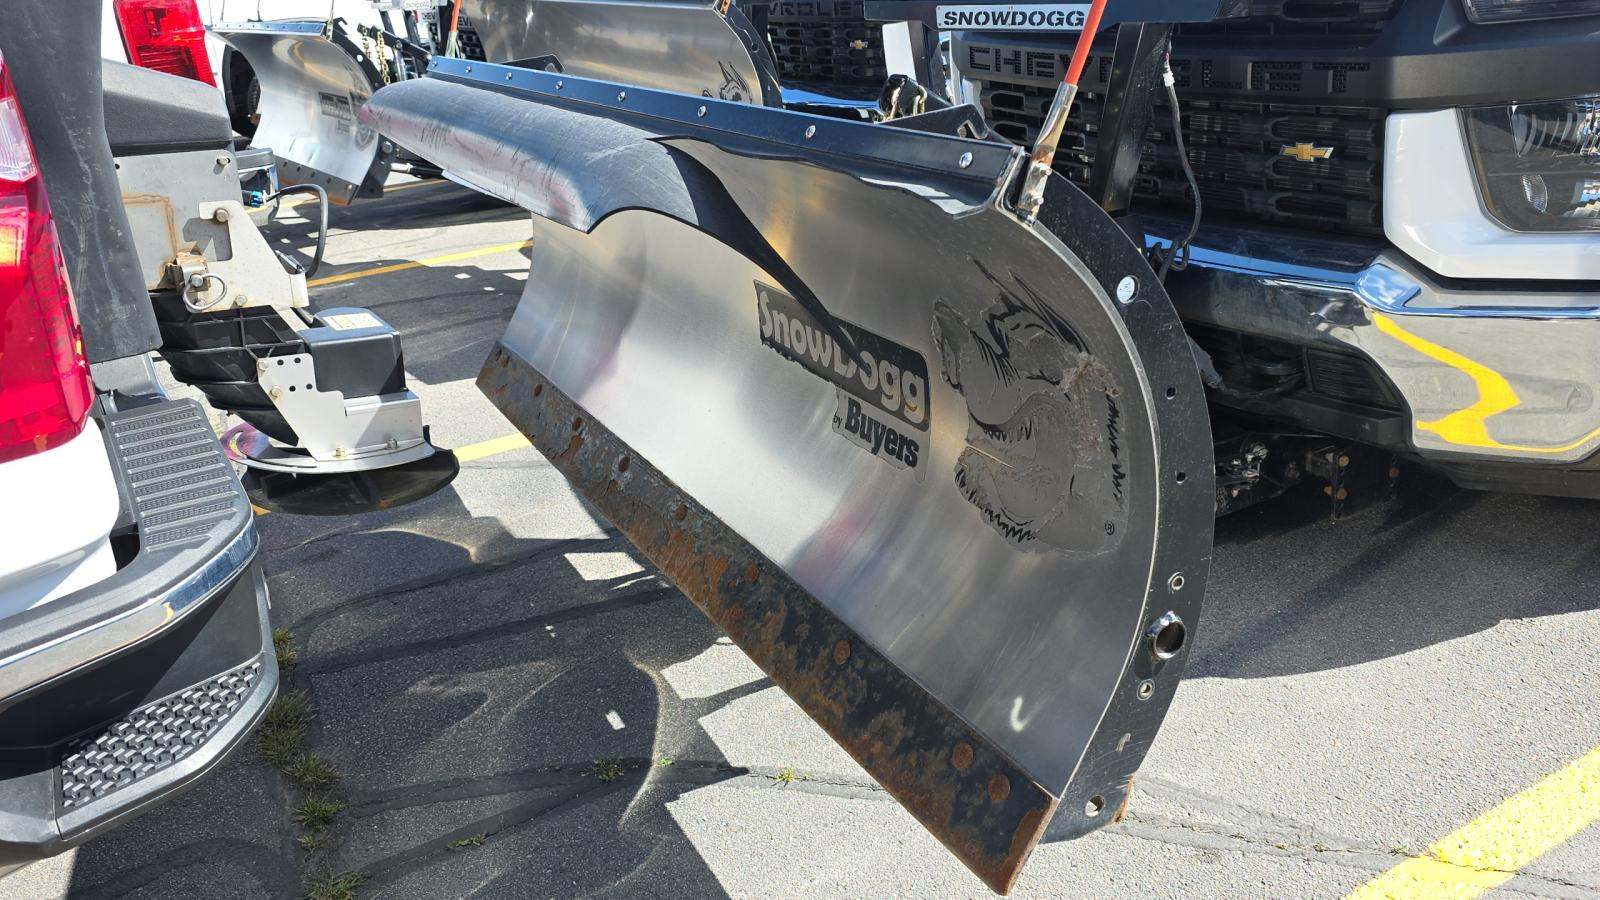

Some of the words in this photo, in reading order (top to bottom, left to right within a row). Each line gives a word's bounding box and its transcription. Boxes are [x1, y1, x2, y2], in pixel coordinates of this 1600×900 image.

[943, 10, 1086, 27] SNOWDOGG
[759, 290, 925, 424] SnowDogg
[832, 414, 843, 428] by
[844, 397, 920, 468] Buyers
